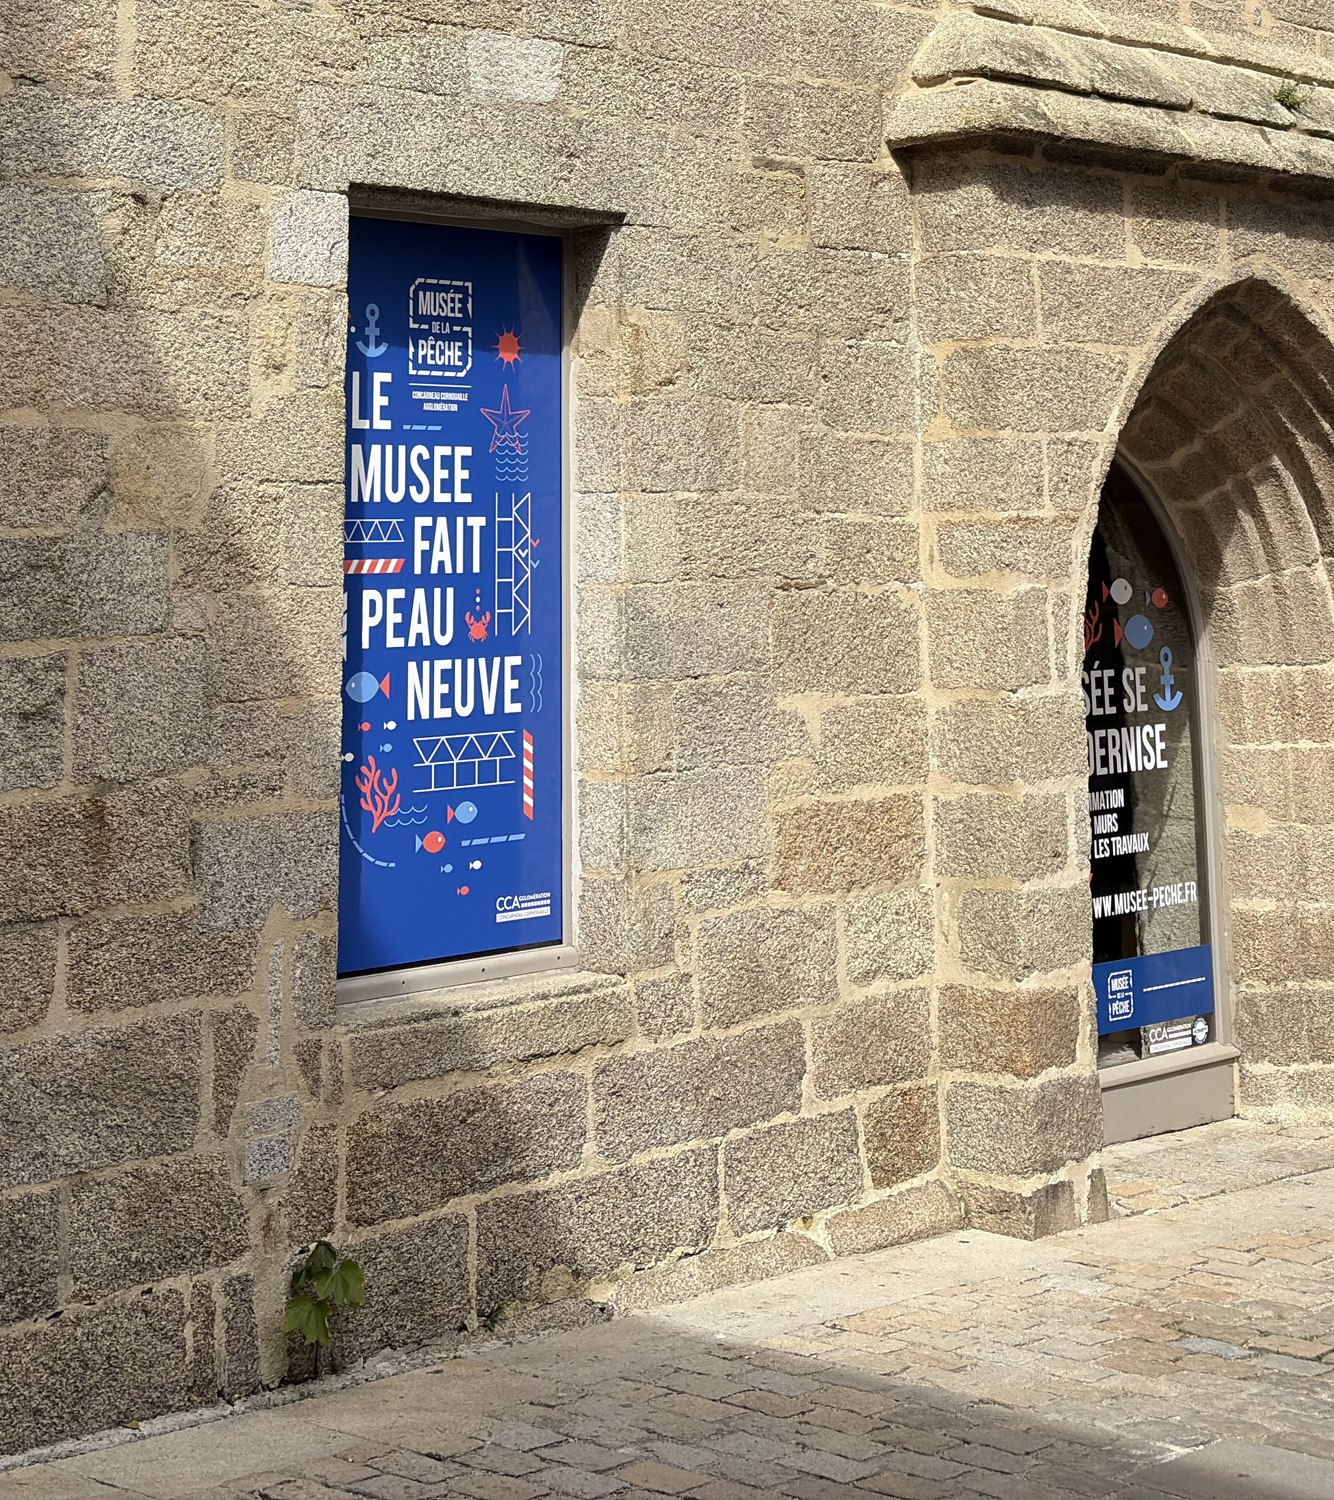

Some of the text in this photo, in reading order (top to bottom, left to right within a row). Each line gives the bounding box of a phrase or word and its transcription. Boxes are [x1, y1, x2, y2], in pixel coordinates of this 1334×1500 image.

[418, 289, 463, 318] MUSÉE
[431, 321, 451, 334] DE LA
[417, 335, 463, 367] PÊCHE
[351, 371, 393, 431] LE
[351, 444, 473, 504] MUSEE
[414, 516, 487, 575] FAIT
[361, 587, 455, 649] PEAU
[407, 655, 522, 721] NEUVE
[1081, 660, 1149, 717] SÉE SE
[1086, 723, 1169, 778] DERNISE
[1088, 788, 1125, 812] MATION
[1093, 813, 1119, 835] MURS
[1094, 832, 1150, 859] LES TRAVAUX
[495, 894, 521, 911] CCA
[1092, 881, 1199, 919] WW.MUSEE-PECHE.FR
[1110, 974, 1130, 992] MUSÉE
[1111, 999, 1131, 1016] PÊCHE
[1149, 1026, 1169, 1043] CCA
